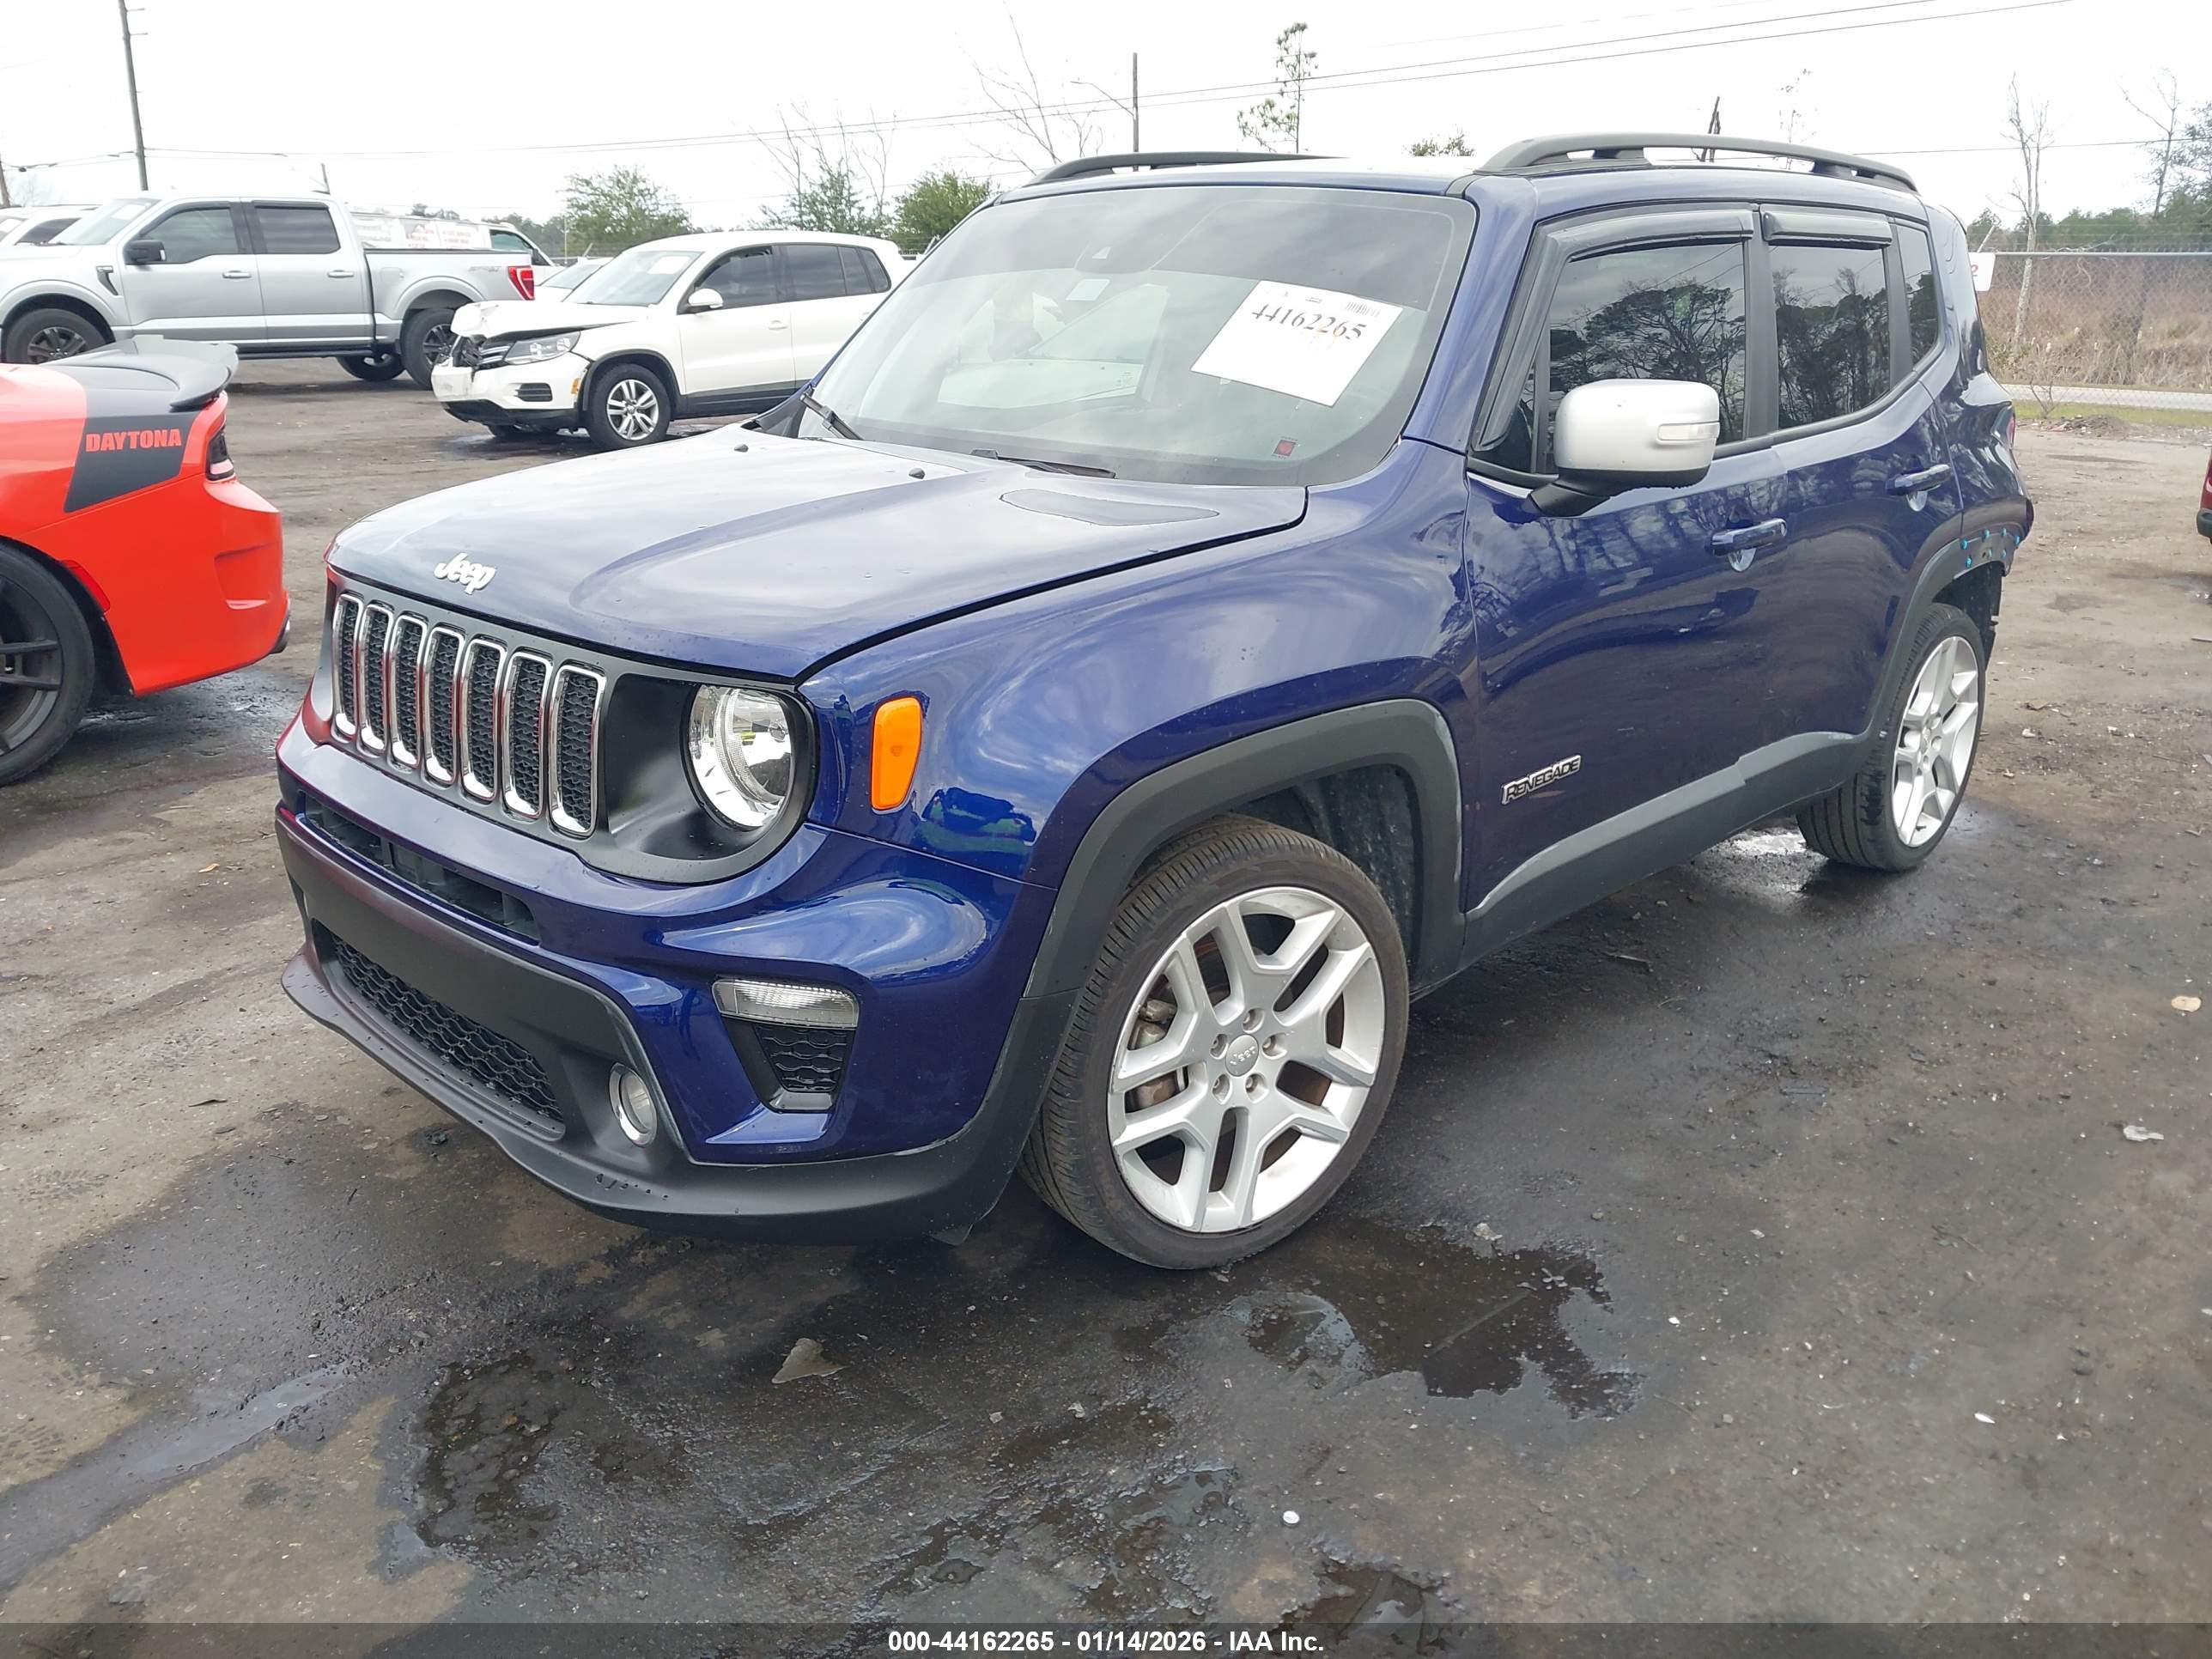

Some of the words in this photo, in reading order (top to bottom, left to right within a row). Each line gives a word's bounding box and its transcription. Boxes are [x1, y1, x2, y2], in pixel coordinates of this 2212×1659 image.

[1251, 303, 1367, 340] 44162265
[86, 428, 182, 452] DAYTONA
[434, 552, 496, 594] Jeep
